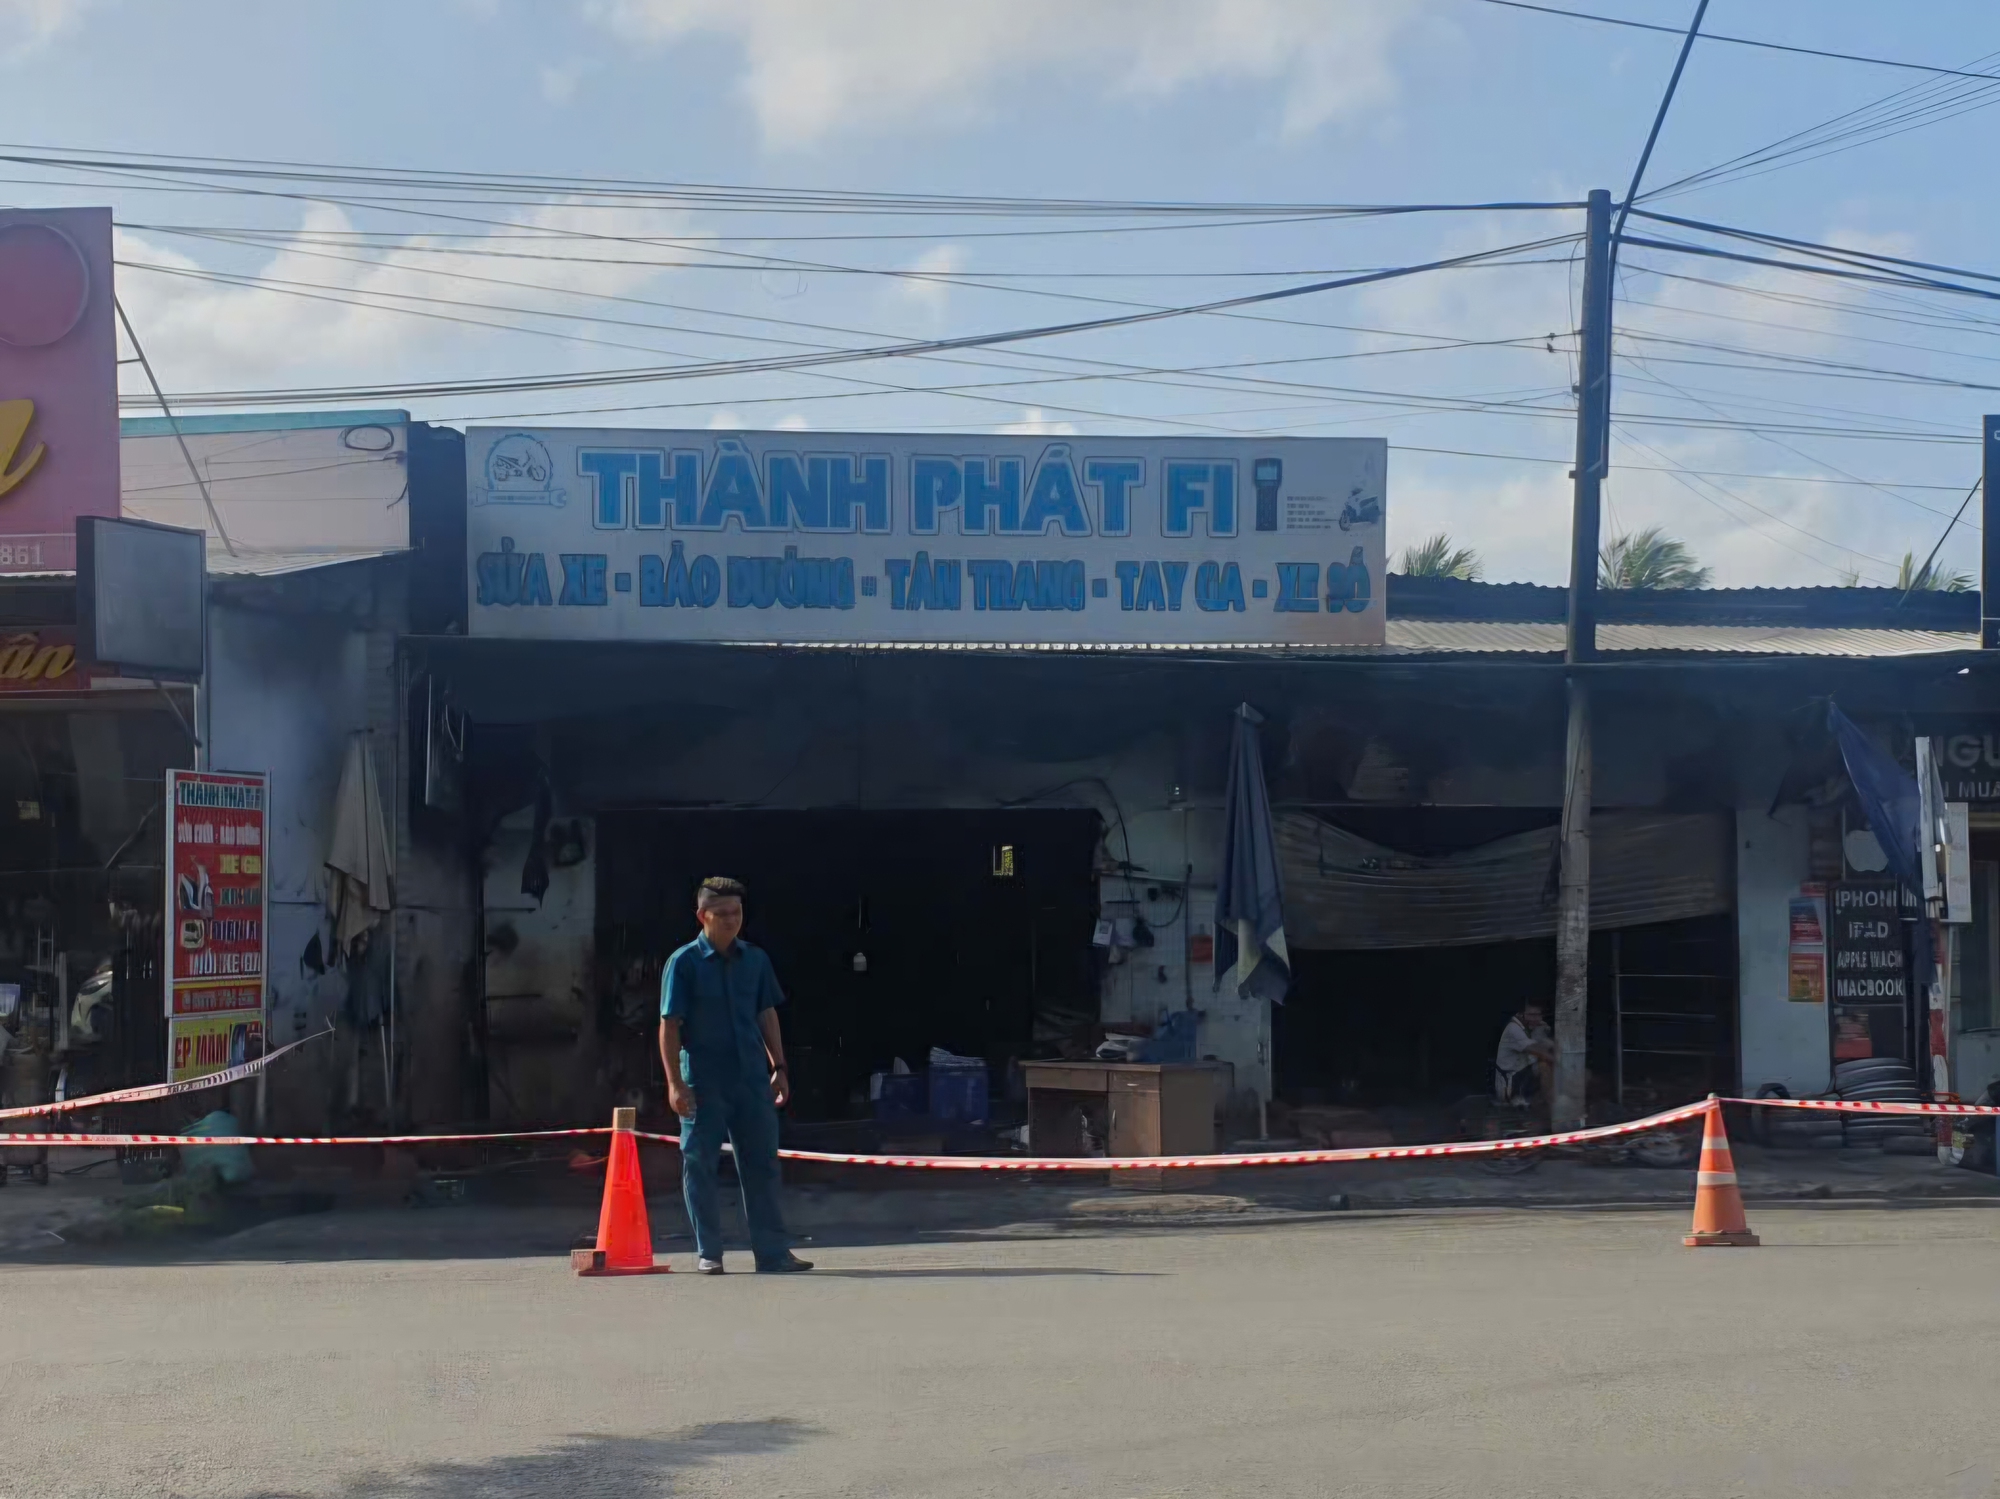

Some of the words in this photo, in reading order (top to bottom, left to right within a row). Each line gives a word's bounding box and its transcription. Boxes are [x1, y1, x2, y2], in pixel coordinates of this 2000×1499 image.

[577, 438, 892, 534] THÀNH
[909, 442, 1146, 537] PHÁT
[1161, 457, 1238, 538] FI
[558, 553, 608, 606] XE
[968, 559, 1086, 611] TRANG
[1116, 560, 1189, 612] TAY
[1195, 561, 1246, 612] GA
[1837, 978, 1904, 997] MACBOOK
